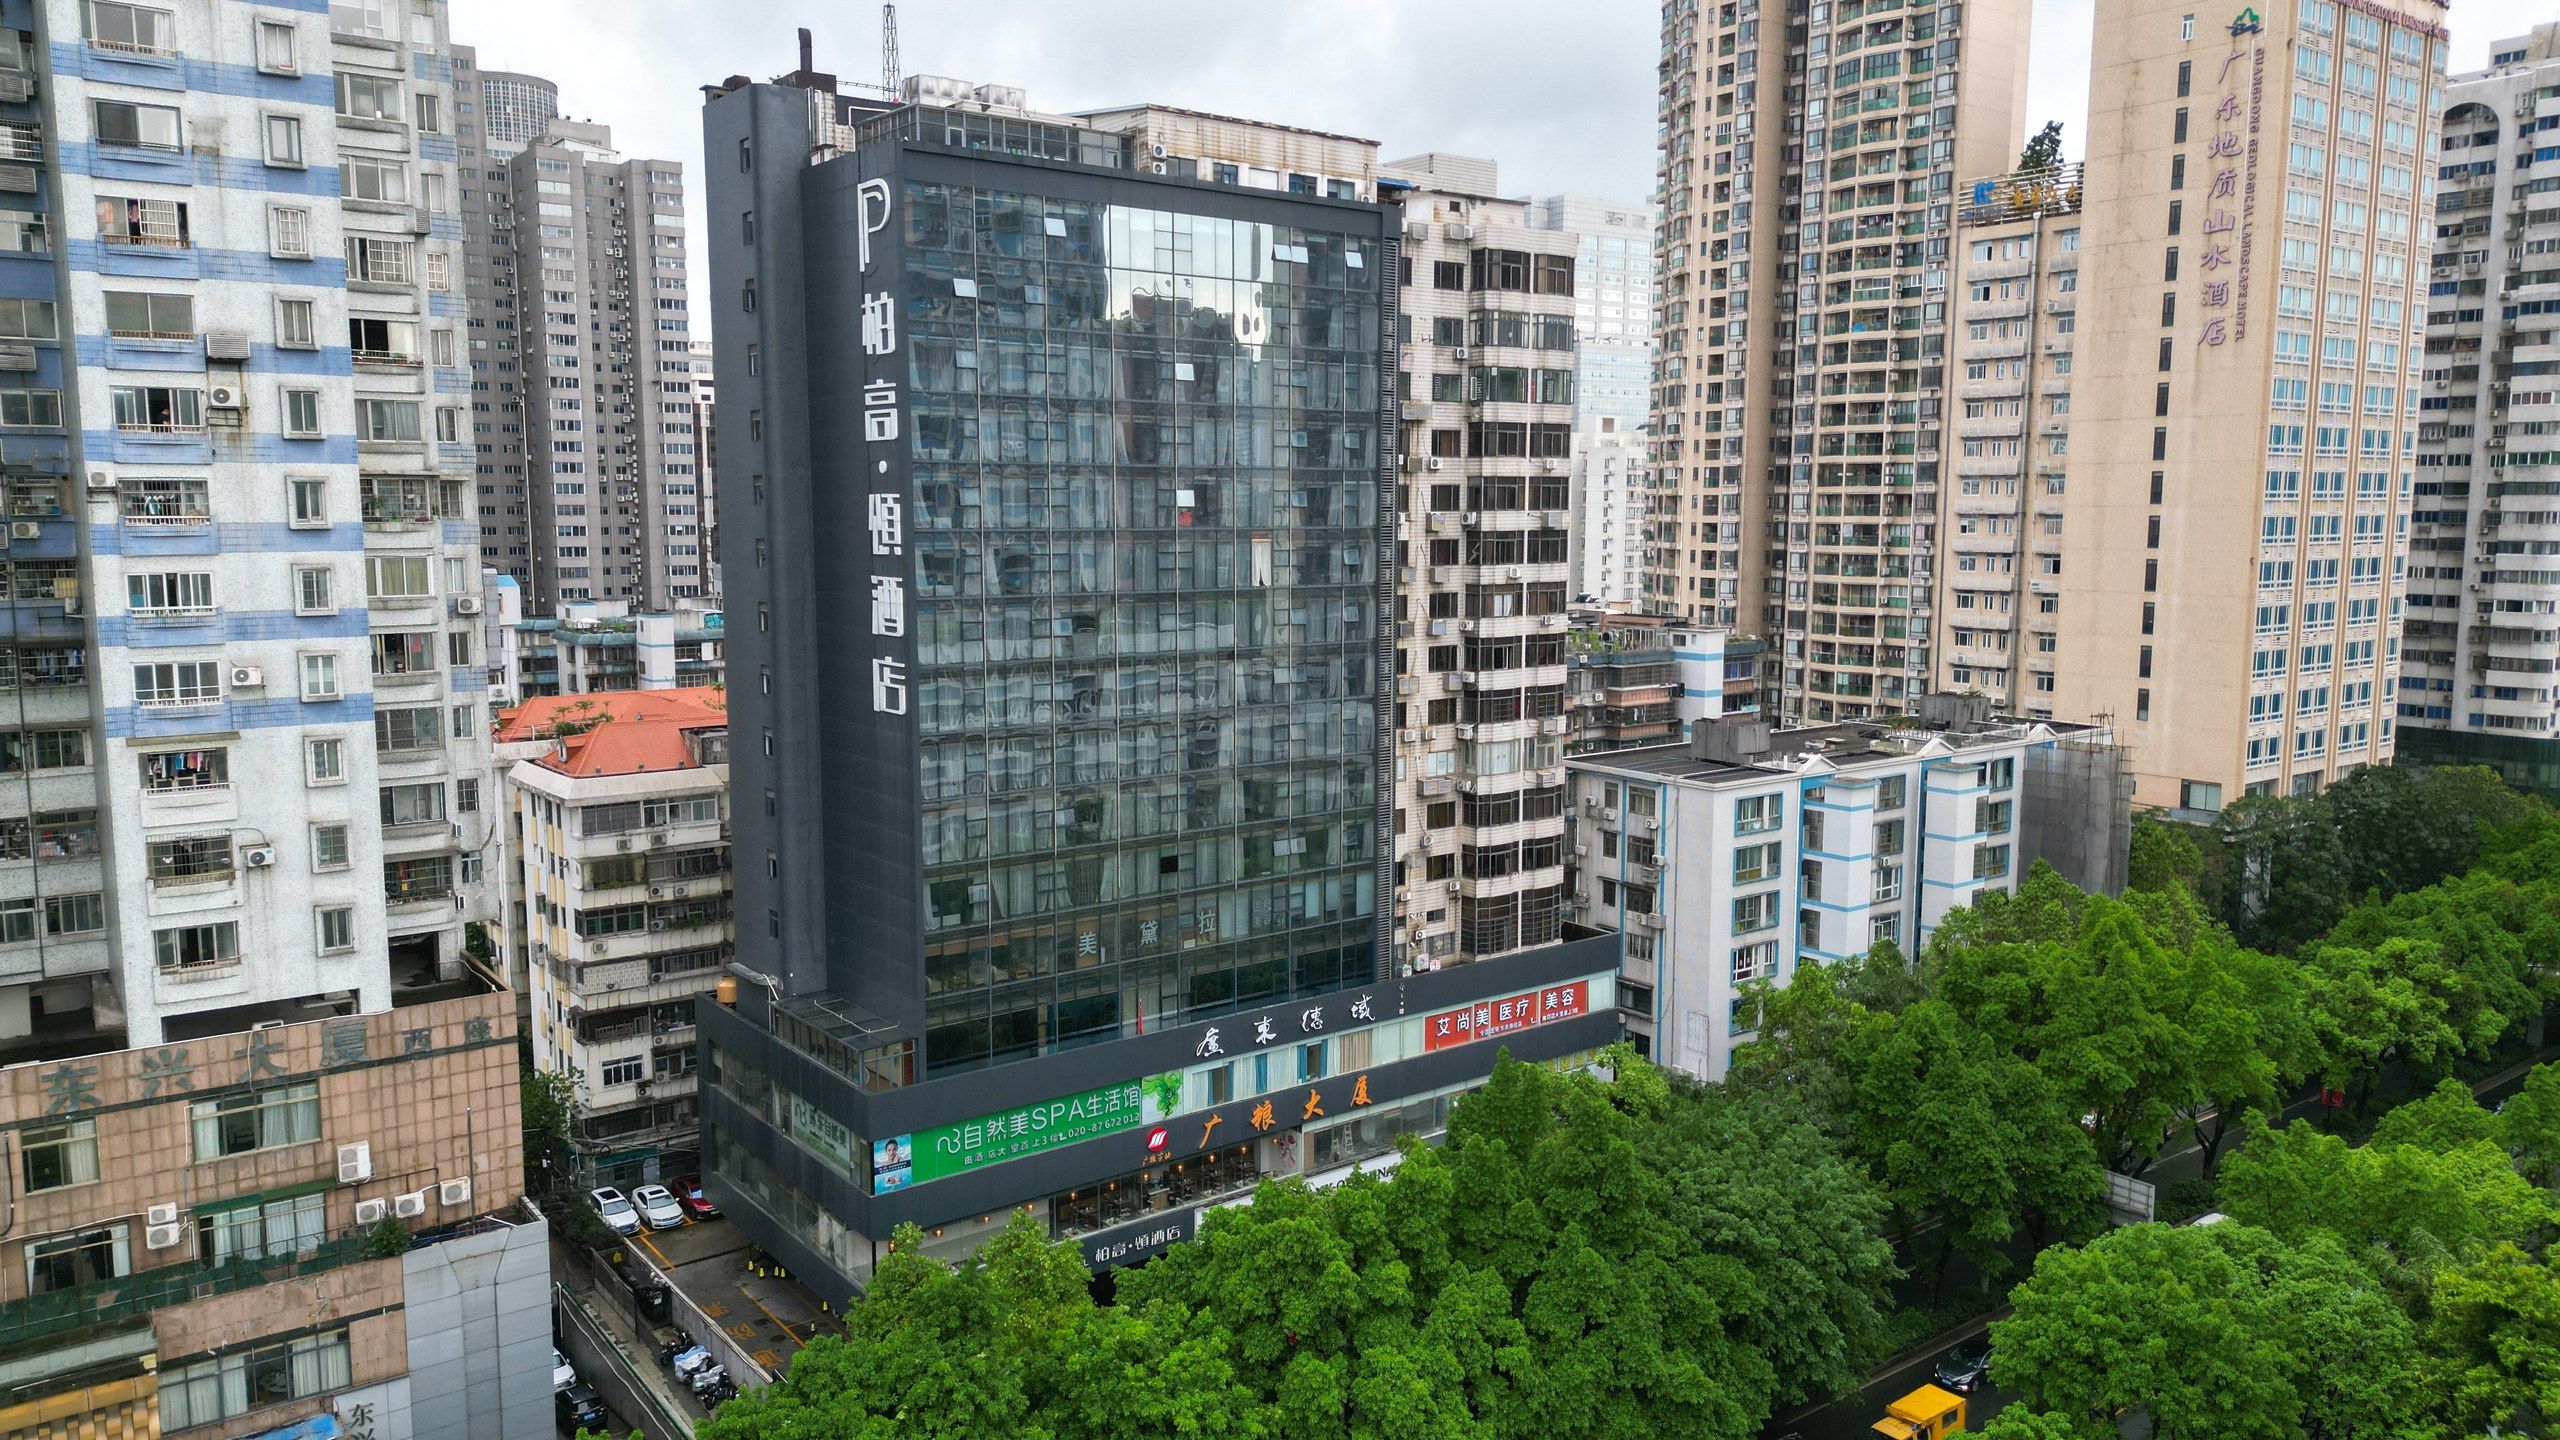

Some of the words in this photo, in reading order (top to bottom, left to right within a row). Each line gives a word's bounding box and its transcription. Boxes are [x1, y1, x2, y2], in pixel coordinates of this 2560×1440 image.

[2249, 47, 2264, 133] GUANGDONG
[2198, 50, 2245, 346] 广东地质山水酒店
[2243, 138, 2258, 219] GEOLOGICAL
[2238, 222, 2253, 299] LANDSCAPE
[2234, 301, 2247, 342] HOTEL
[1078, 909, 1216, 957] 美黛拉
[1437, 988, 1574, 1037] 艾尚美医疗美容
[1198, 1084, 1373, 1150] 广粮大厦
